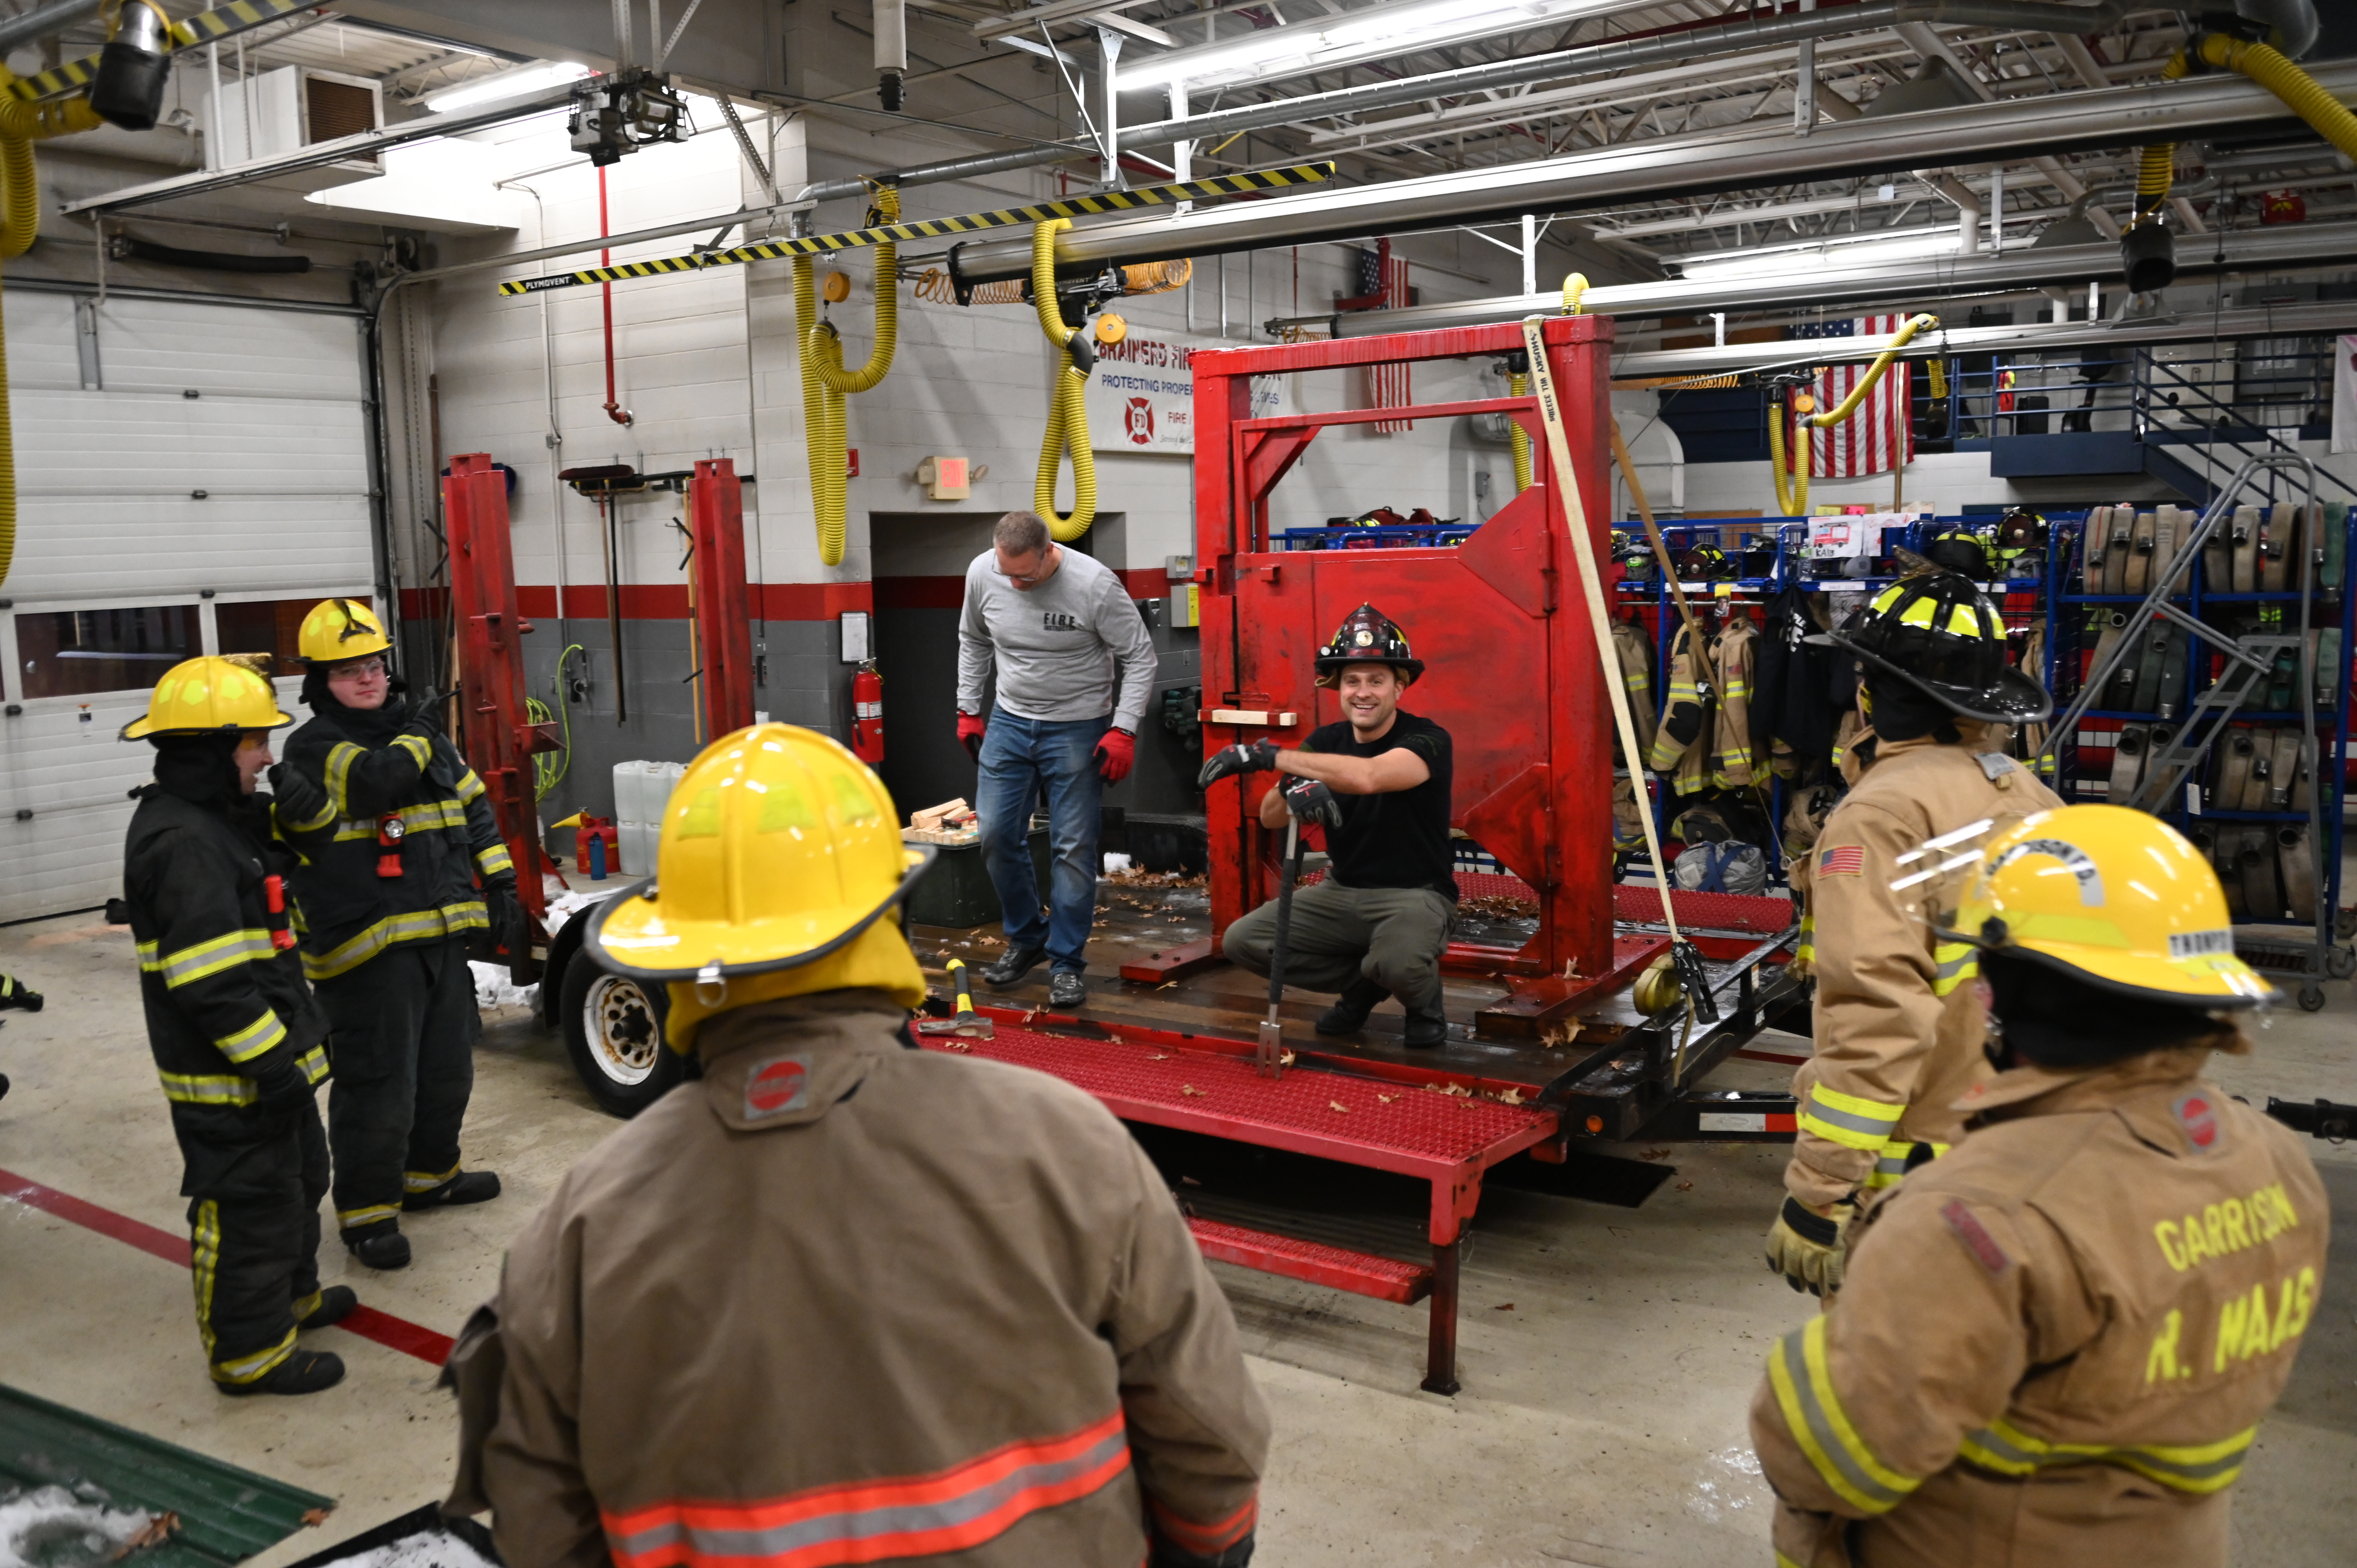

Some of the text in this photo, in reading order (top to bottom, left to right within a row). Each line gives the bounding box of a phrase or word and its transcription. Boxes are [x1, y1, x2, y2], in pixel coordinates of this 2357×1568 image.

[526, 276, 570, 290] PLYMOVENT
[1172, 344, 1199, 371] FIR
[1531, 341, 1544, 373] HUSKY
[1540, 377, 1549, 392] WLL
[1102, 374, 1159, 392] PROTECTING
[1134, 413, 1146, 428] FD
[1168, 411, 1187, 424] FIRE
[1044, 613, 1075, 627] FIRE
